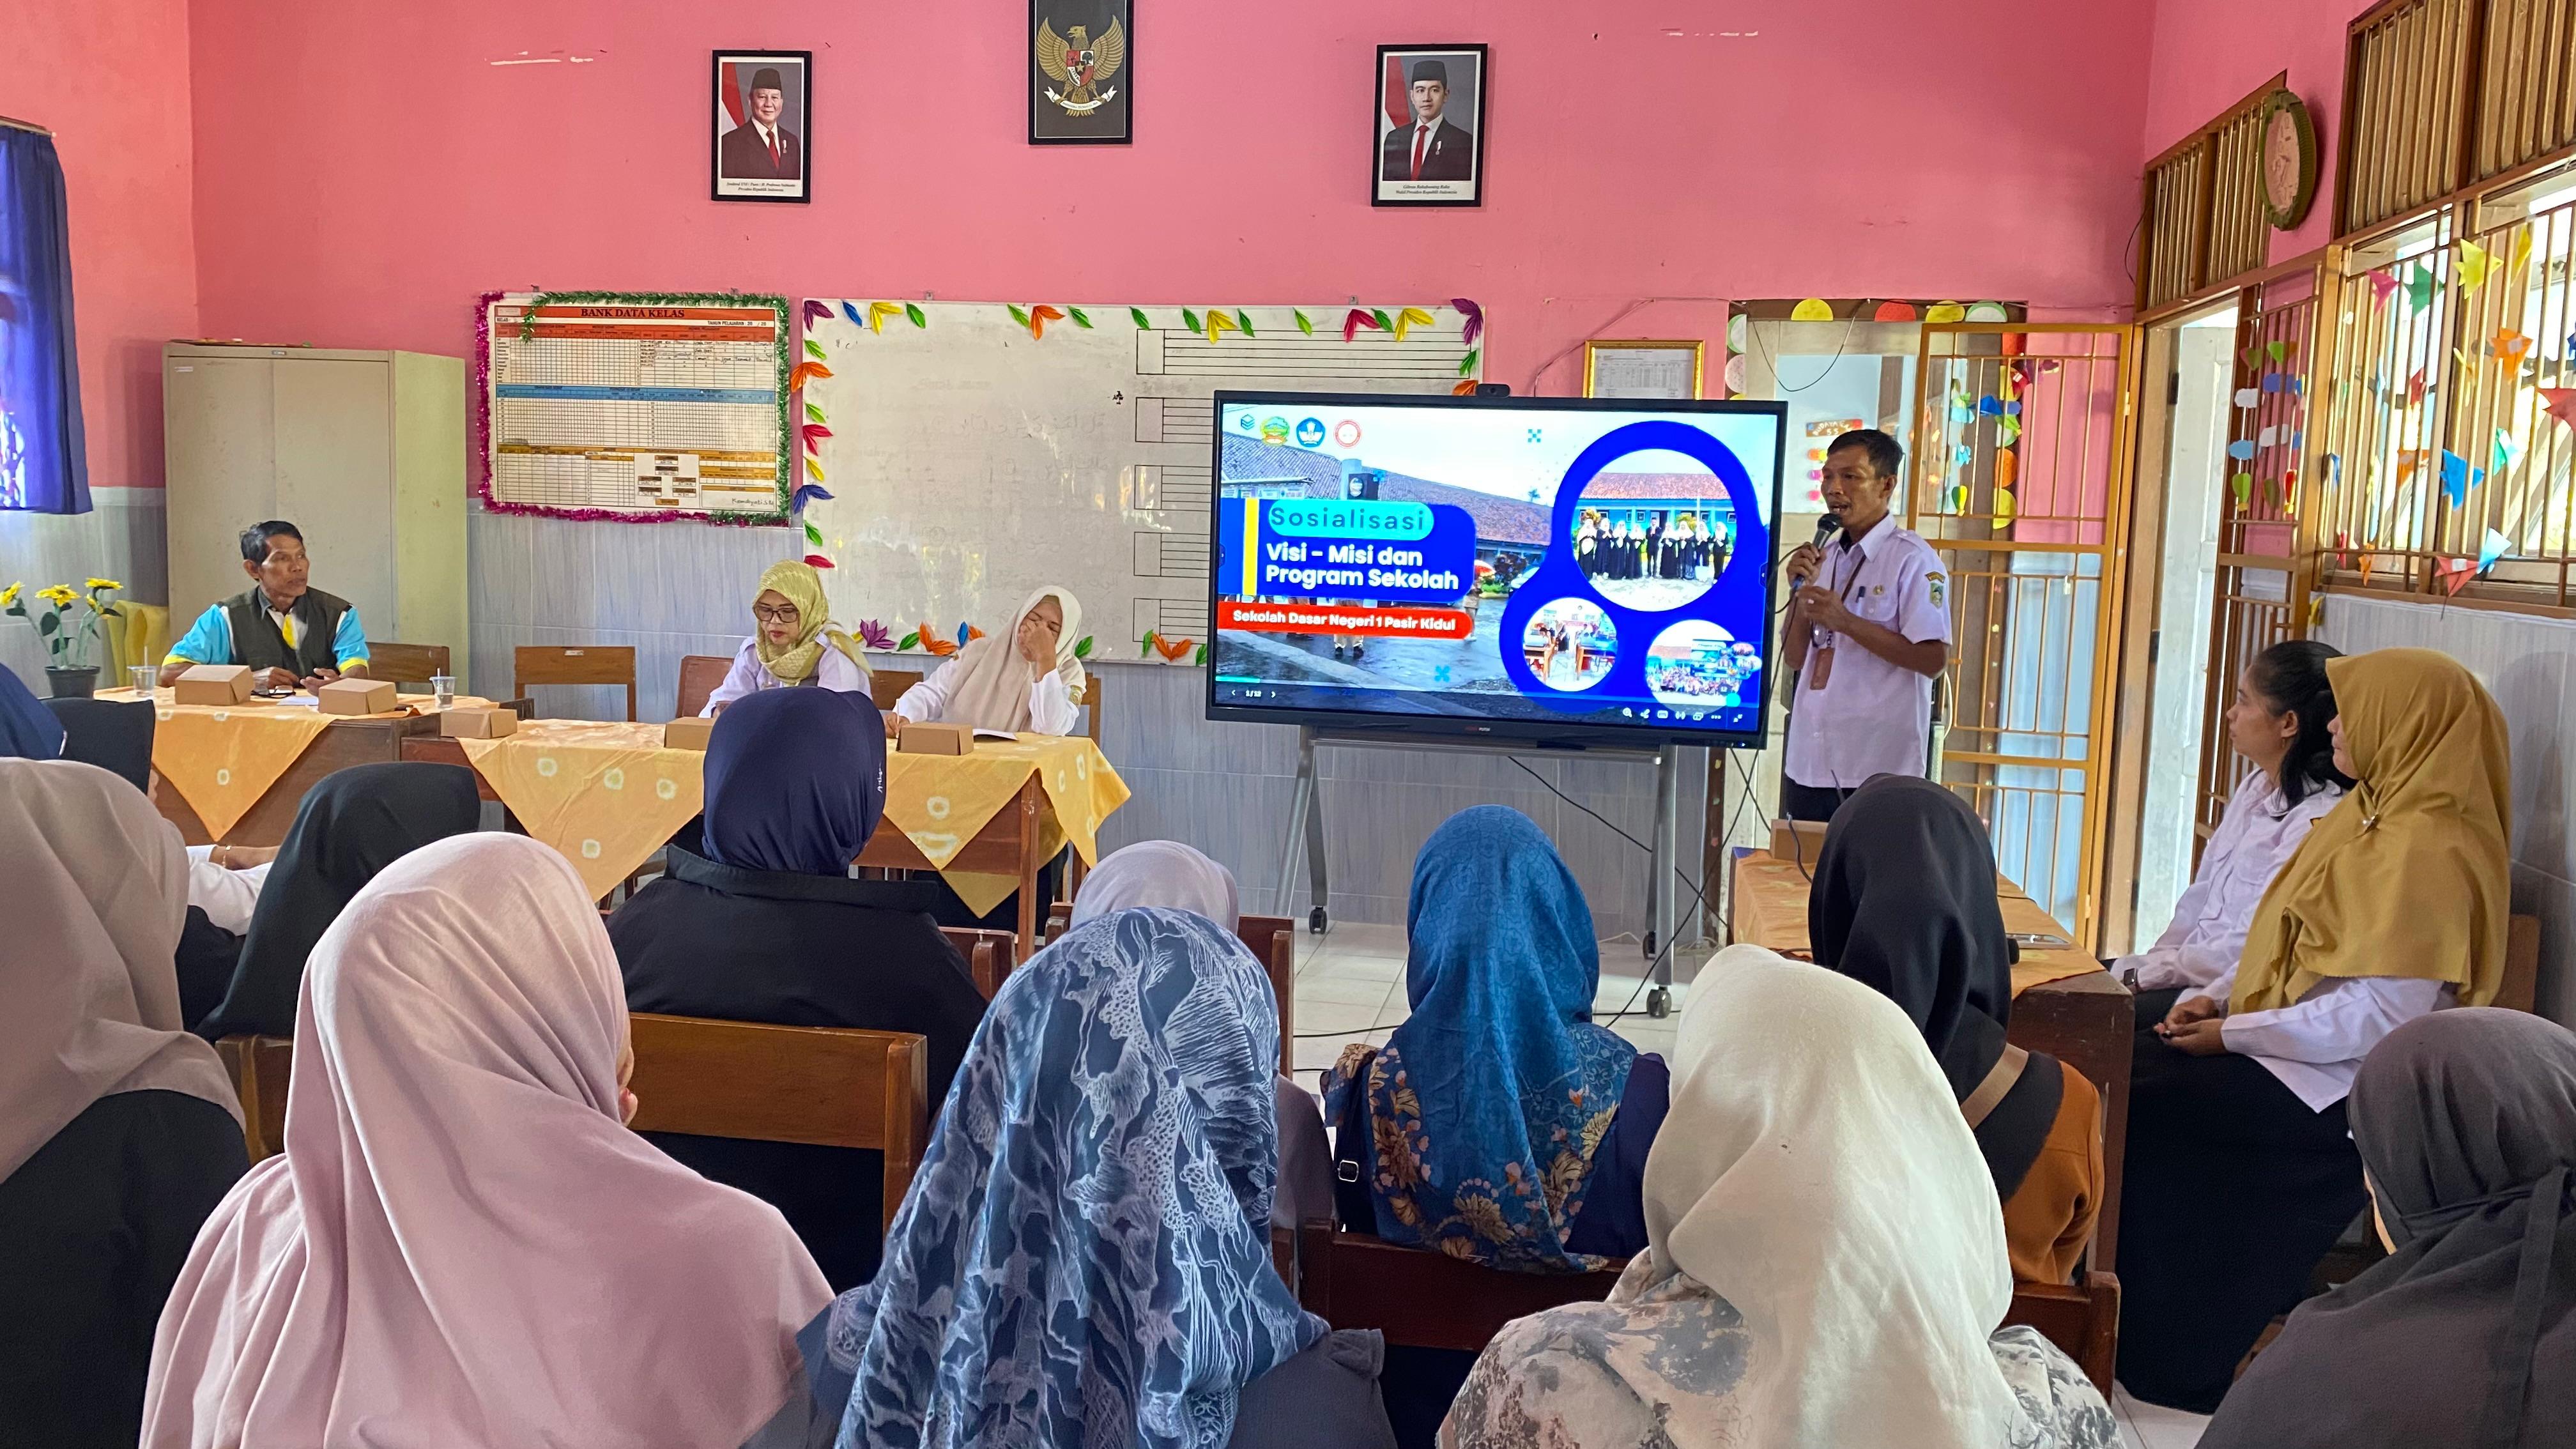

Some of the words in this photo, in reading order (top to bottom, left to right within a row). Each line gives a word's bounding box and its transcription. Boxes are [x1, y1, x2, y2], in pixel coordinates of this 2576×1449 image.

[581, 309, 613, 317] BANK
[615, 309, 645, 318] DATA
[648, 309, 685, 318] KELAS
[1271, 507, 1424, 531] Sosialisasi
[1266, 541, 1307, 562] Visi
[1328, 544, 1374, 565] Misi
[1377, 547, 1423, 567] dan
[1266, 564, 1364, 590] Program
[1368, 569, 1459, 590] Sekolah
[1233, 610, 1286, 623] Sekolah
[1289, 612, 1328, 625] Dasar
[1329, 614, 1374, 629] Negeri
[1376, 617, 1383, 627] 1
[1384, 617, 1418, 629] Pasir
[1420, 617, 1456, 631] Kidul
